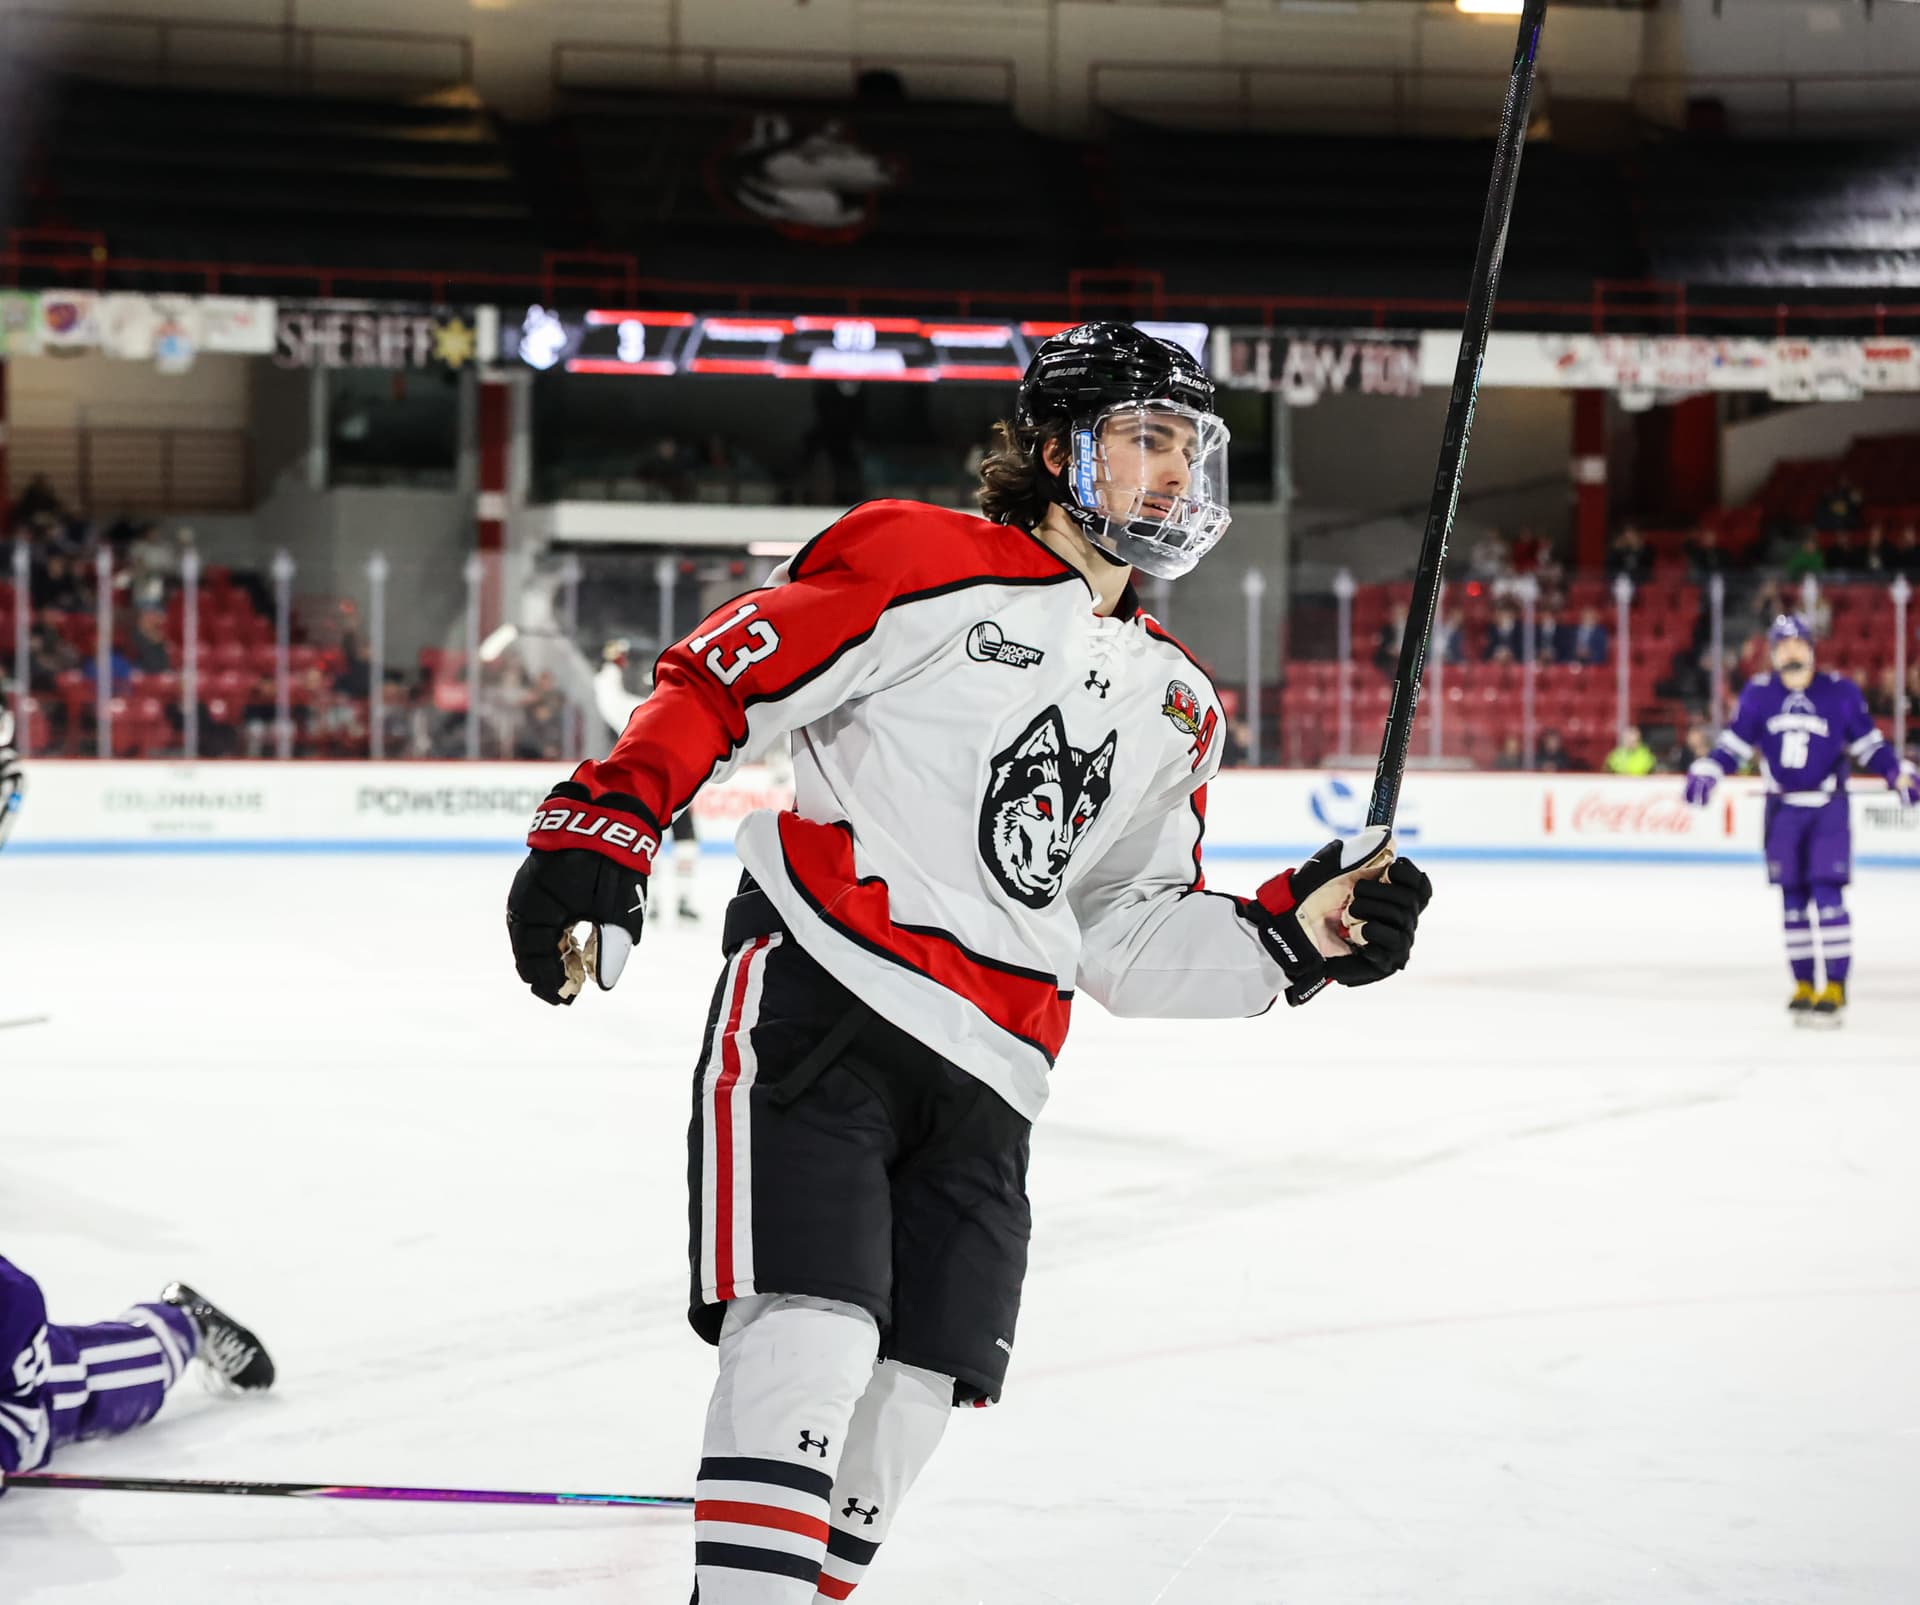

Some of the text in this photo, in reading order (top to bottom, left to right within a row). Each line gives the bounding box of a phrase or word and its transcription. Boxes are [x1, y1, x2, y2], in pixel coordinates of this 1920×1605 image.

[273, 314, 433, 369] SHERIFF
[687, 602, 781, 686] 13
[996, 651, 1023, 665] EAST
[1000, 643, 1041, 661] HOCKEY
[528, 808, 658, 862] BAUER
[1267, 927, 1299, 963] BAUER
